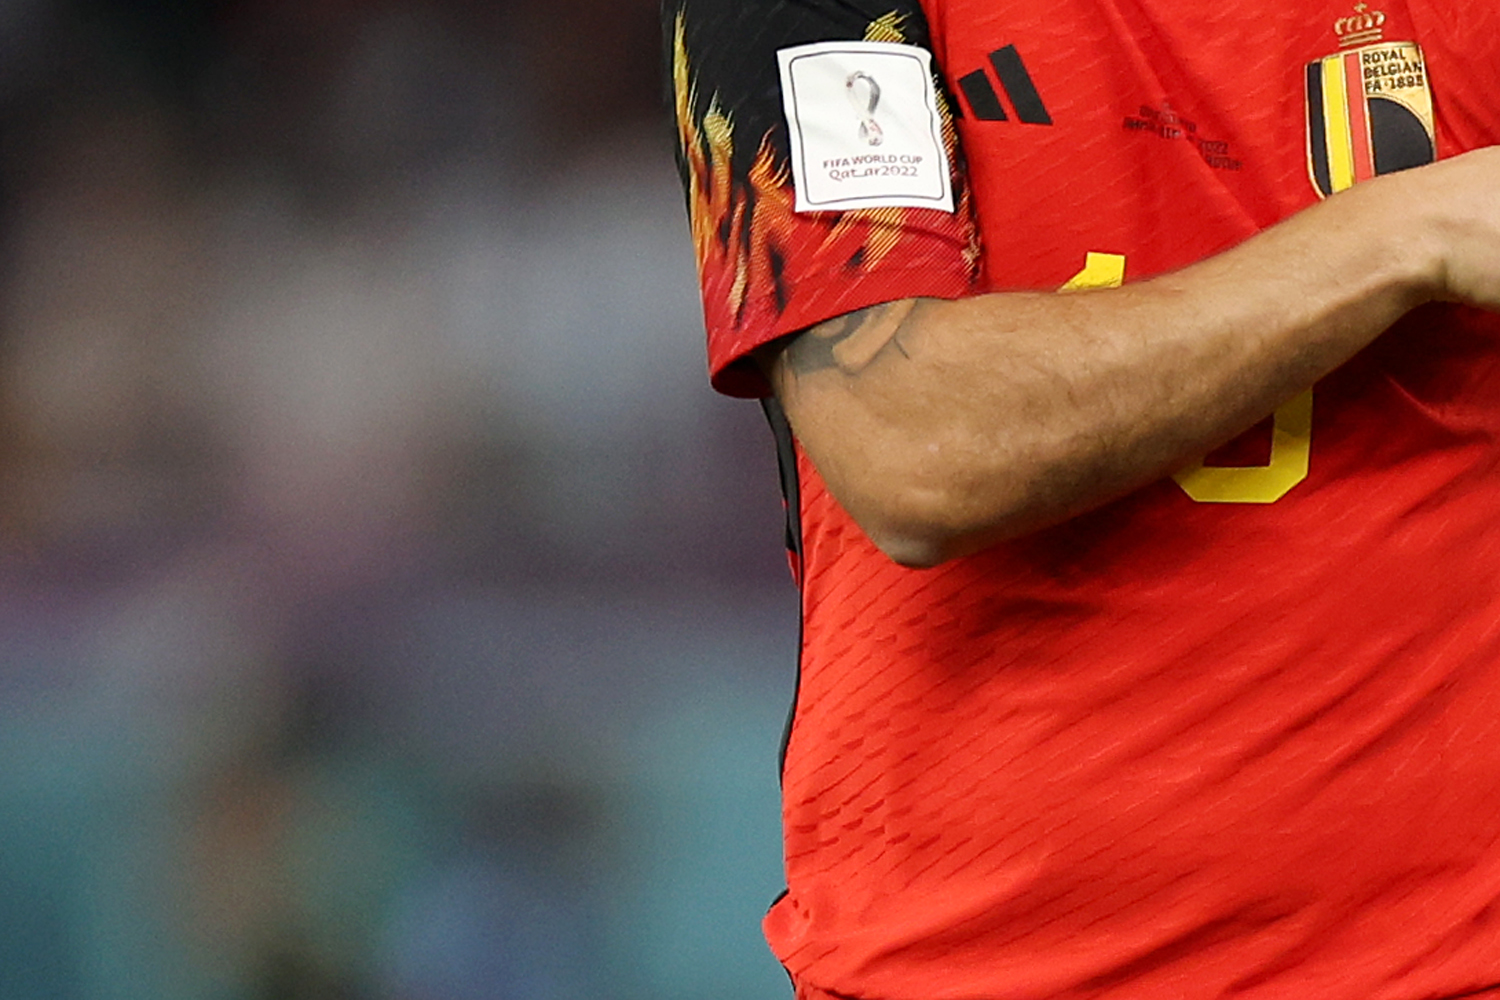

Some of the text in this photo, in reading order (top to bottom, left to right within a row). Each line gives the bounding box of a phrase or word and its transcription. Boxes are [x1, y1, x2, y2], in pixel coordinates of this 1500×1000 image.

[1363, 48, 1407, 65] ROYAL
[1363, 61, 1423, 80] BELGIAN
[823, 154, 923, 169] FIFA WORLD CUP
